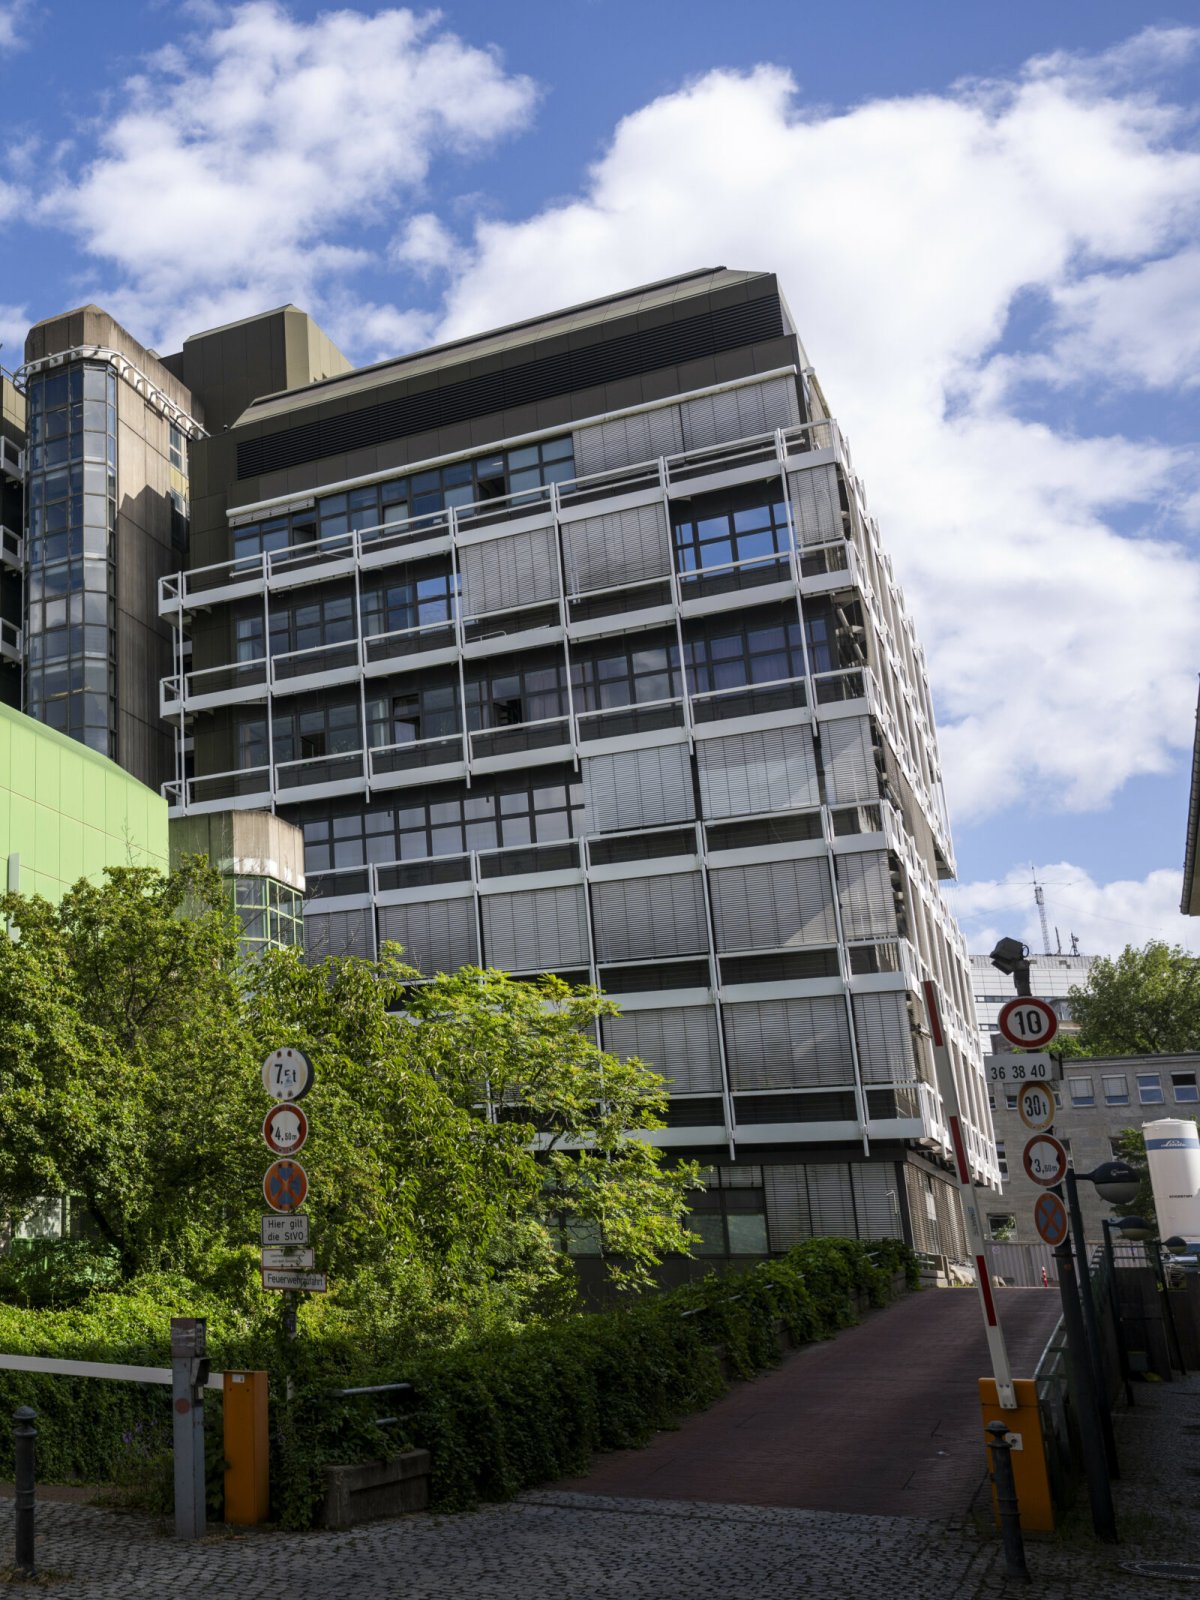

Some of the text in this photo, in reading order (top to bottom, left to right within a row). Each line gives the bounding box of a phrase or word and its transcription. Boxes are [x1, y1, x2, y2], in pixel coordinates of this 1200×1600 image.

[1014, 1010, 1042, 1035] 10
[991, 1064, 1046, 1080] 36 38 40
[268, 1219, 303, 1230] Hier gilt
[267, 1231, 304, 1241] die StVO
